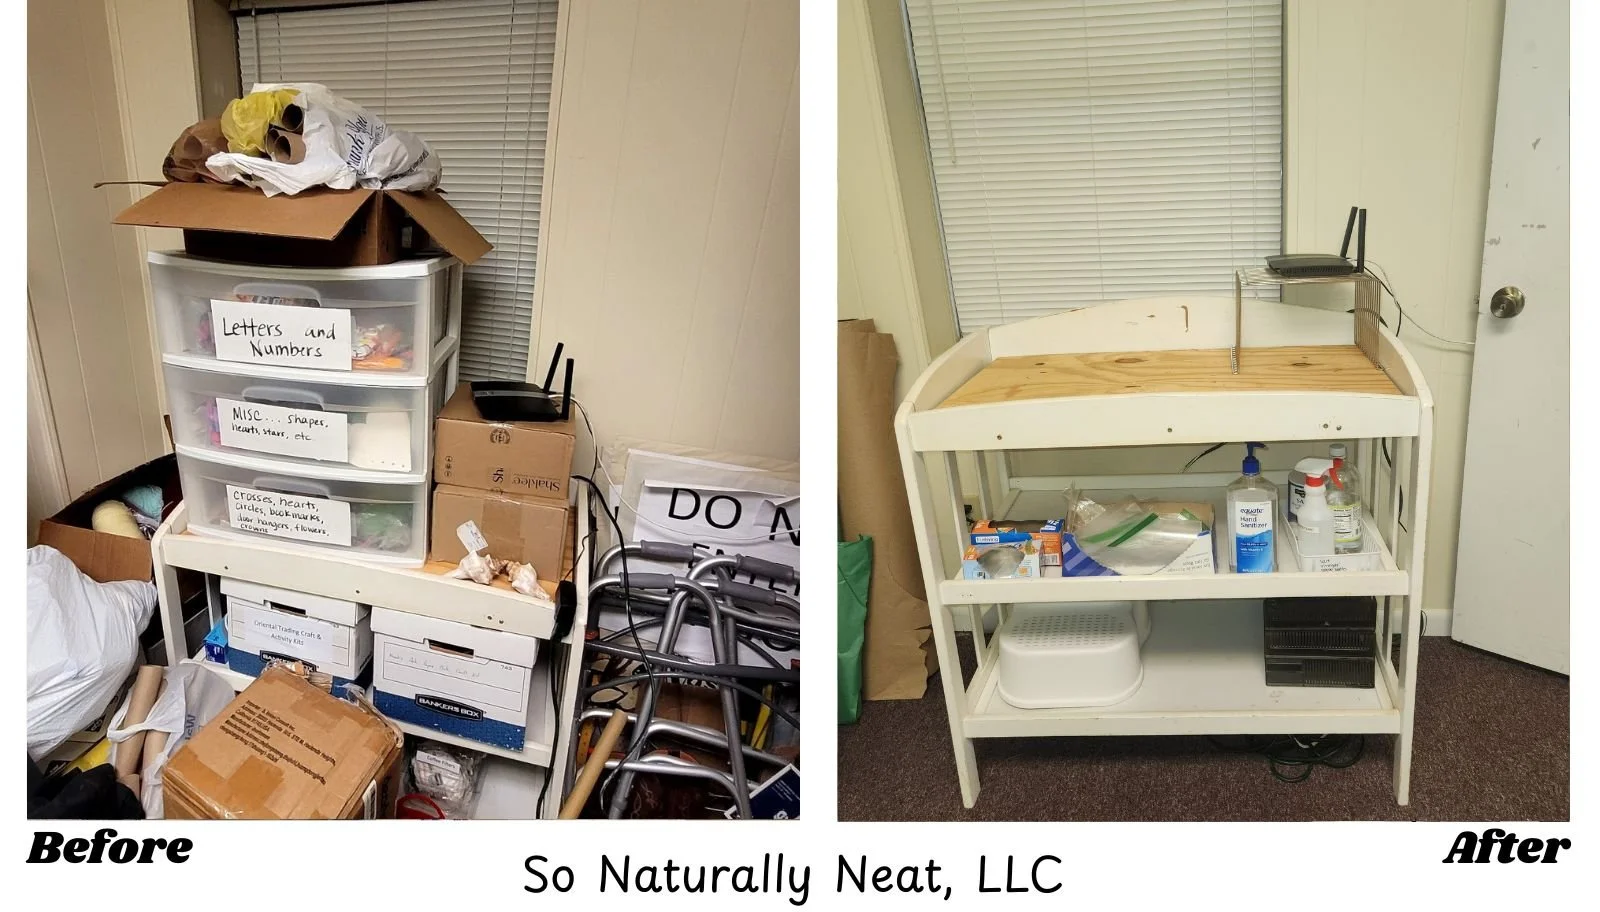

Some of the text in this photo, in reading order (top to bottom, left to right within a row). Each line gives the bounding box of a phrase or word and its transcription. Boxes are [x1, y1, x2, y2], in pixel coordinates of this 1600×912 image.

[222, 317, 336, 340] Letters and
[250, 340, 323, 358] Numbers
[294, 432, 312, 441] etc
[512, 475, 561, 492] Shaklee
[667, 487, 742, 530] DO
[240, 523, 268, 533] crowns
[254, 620, 278, 632] Oriental
[278, 624, 300, 636] Trading
[300, 630, 315, 639] Craft
[270, 633, 304, 646] Activity Kits
[419, 697, 480, 718] BANKERS BOX
[426, 754, 442, 764] Coffee
